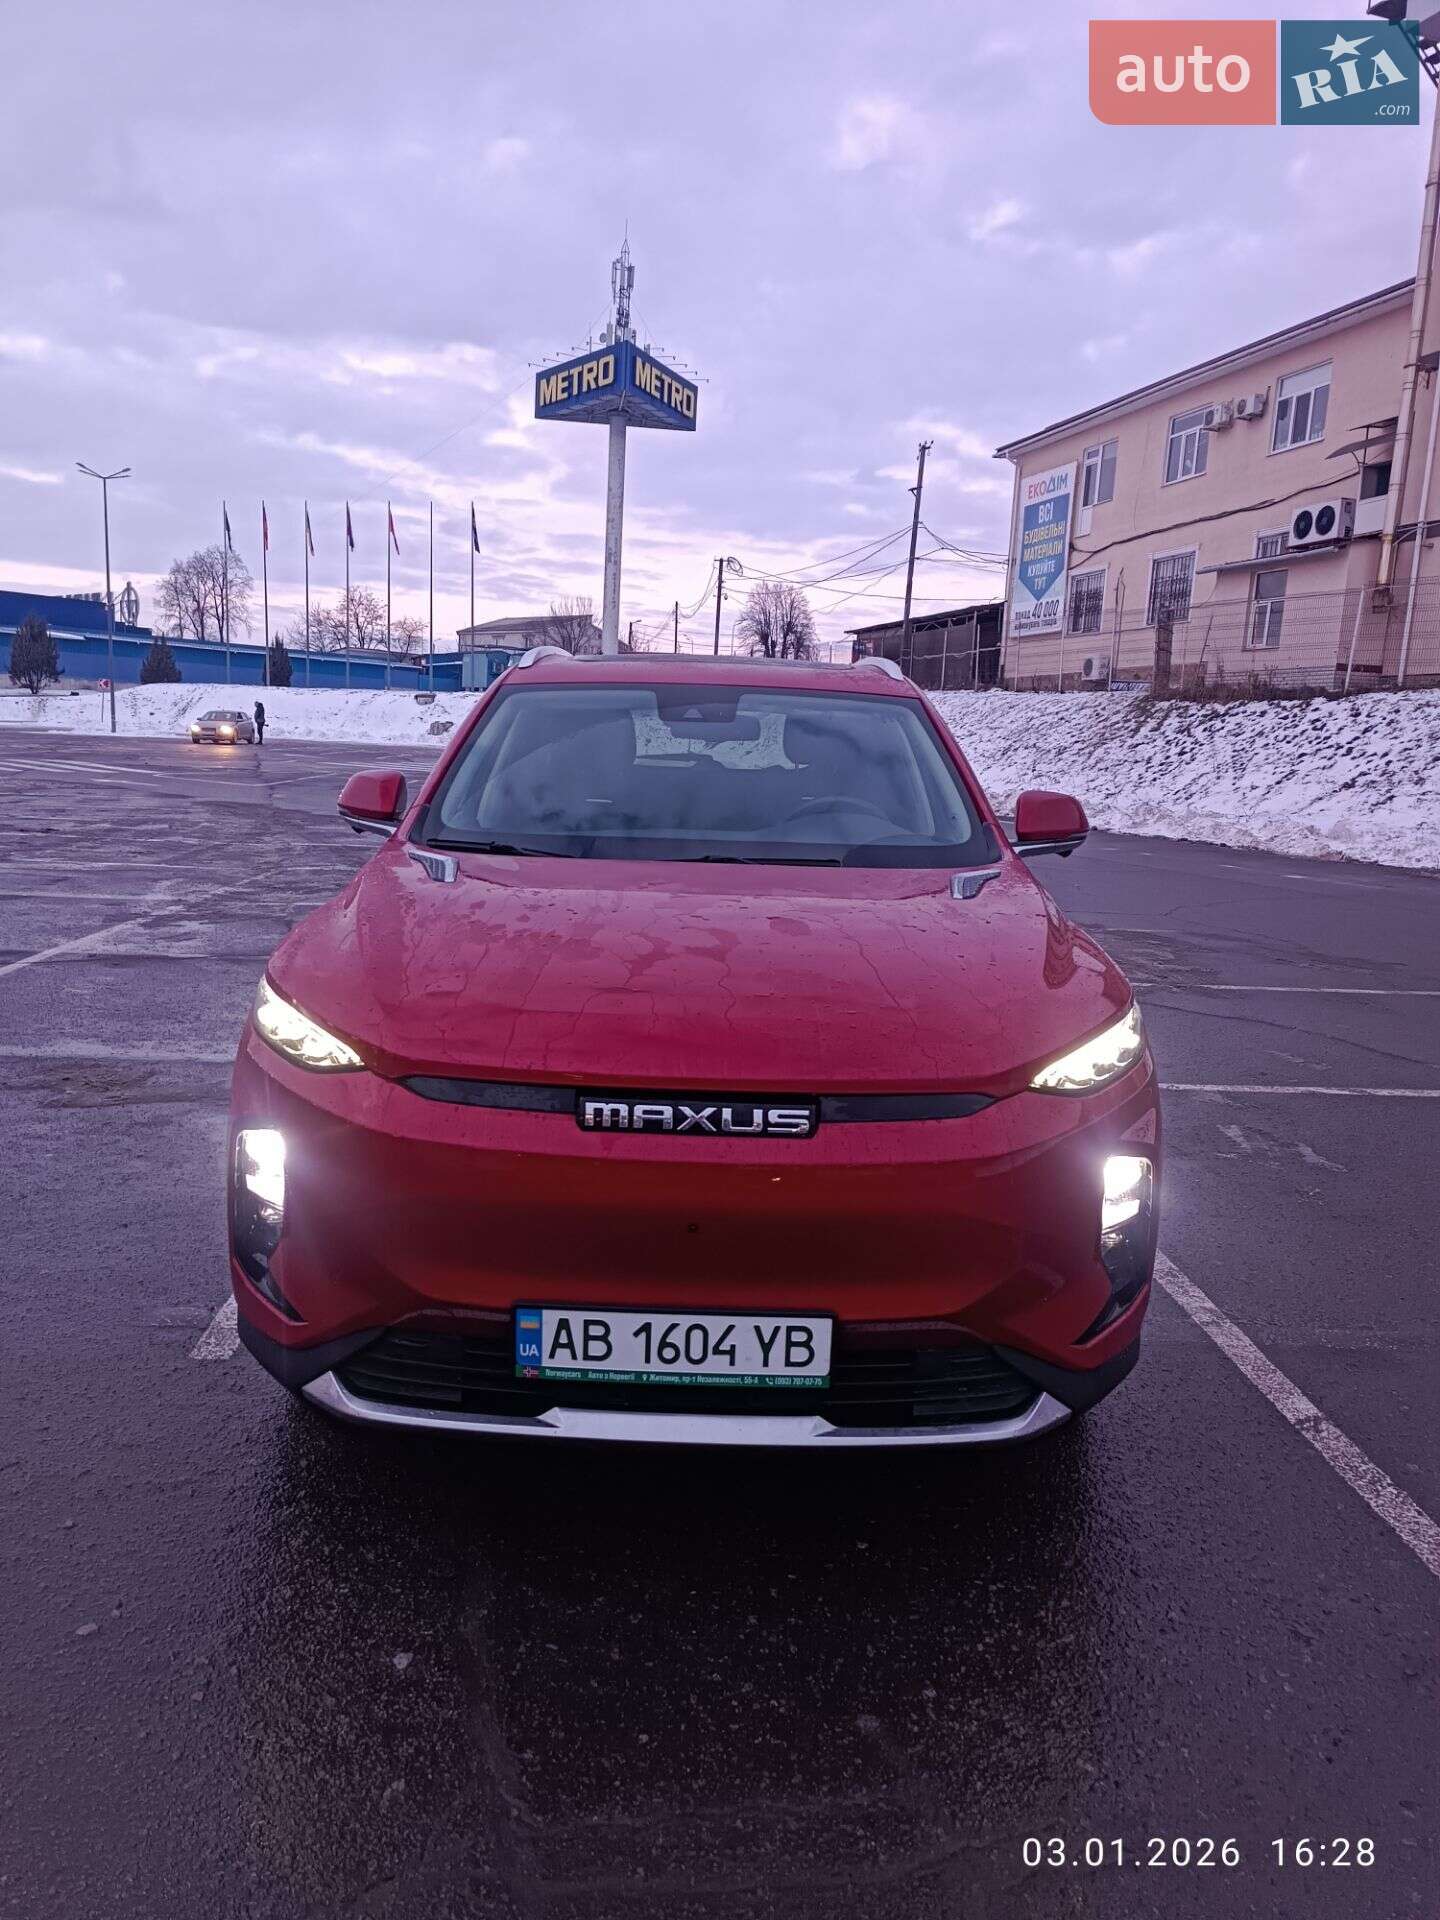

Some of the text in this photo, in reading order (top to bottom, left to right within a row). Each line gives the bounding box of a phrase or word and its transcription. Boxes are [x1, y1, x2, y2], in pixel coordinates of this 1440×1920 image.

[539, 354, 615, 407] METRO
[635, 356, 695, 418] METRO
[1038, 501, 1054, 524] ВСІ
[1024, 521, 1066, 545] БУДІВЕЛЬНІ
[1031, 601, 1043, 619] 40
[1043, 599, 1060, 618] 000
[584, 1101, 810, 1135] MAXUS
[519, 1343, 540, 1358] UA
[548, 1317, 816, 1368] AB 1604 YB
